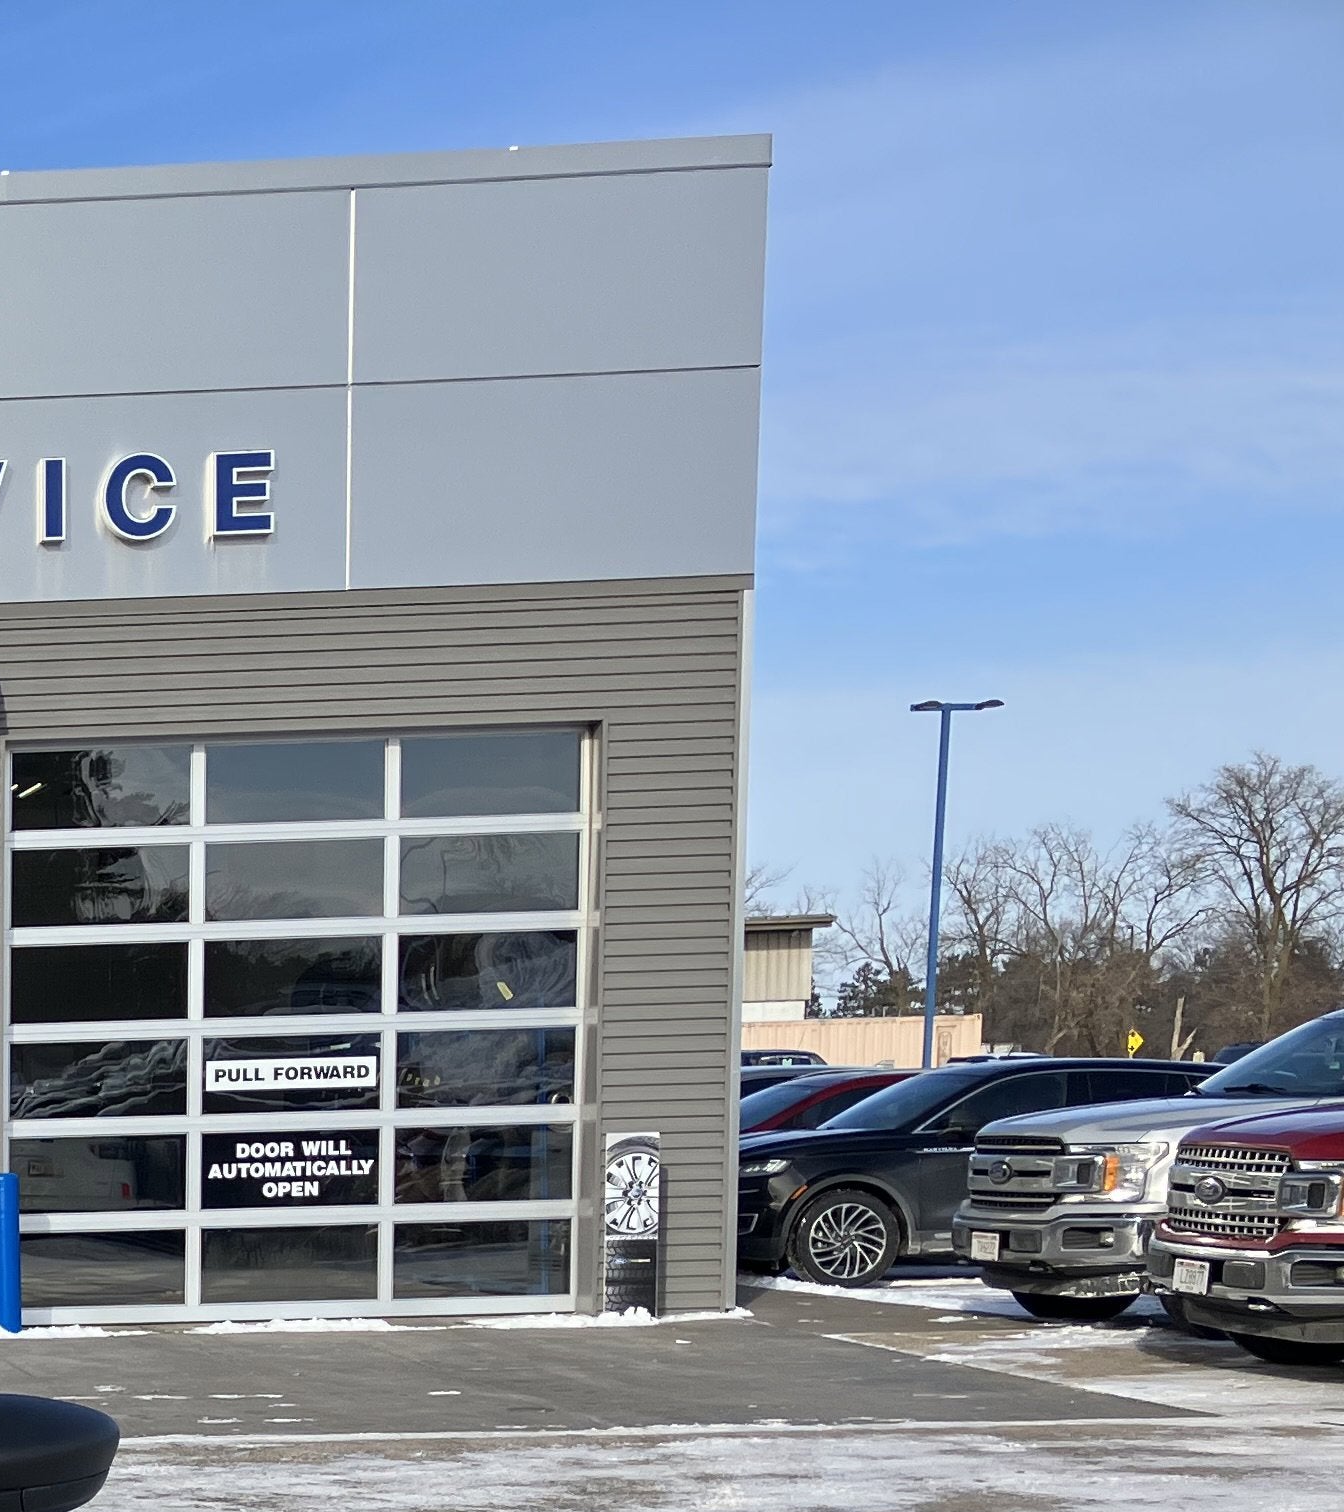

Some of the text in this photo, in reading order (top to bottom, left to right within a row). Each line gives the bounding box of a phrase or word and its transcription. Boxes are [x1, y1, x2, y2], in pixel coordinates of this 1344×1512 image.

[214, 1064, 370, 1083] PULL FORWARD
[236, 1140, 352, 1159] DOOR WILL
[208, 1159, 375, 1179] AUTOMATICALLY
[262, 1181, 320, 1198] OPEN
